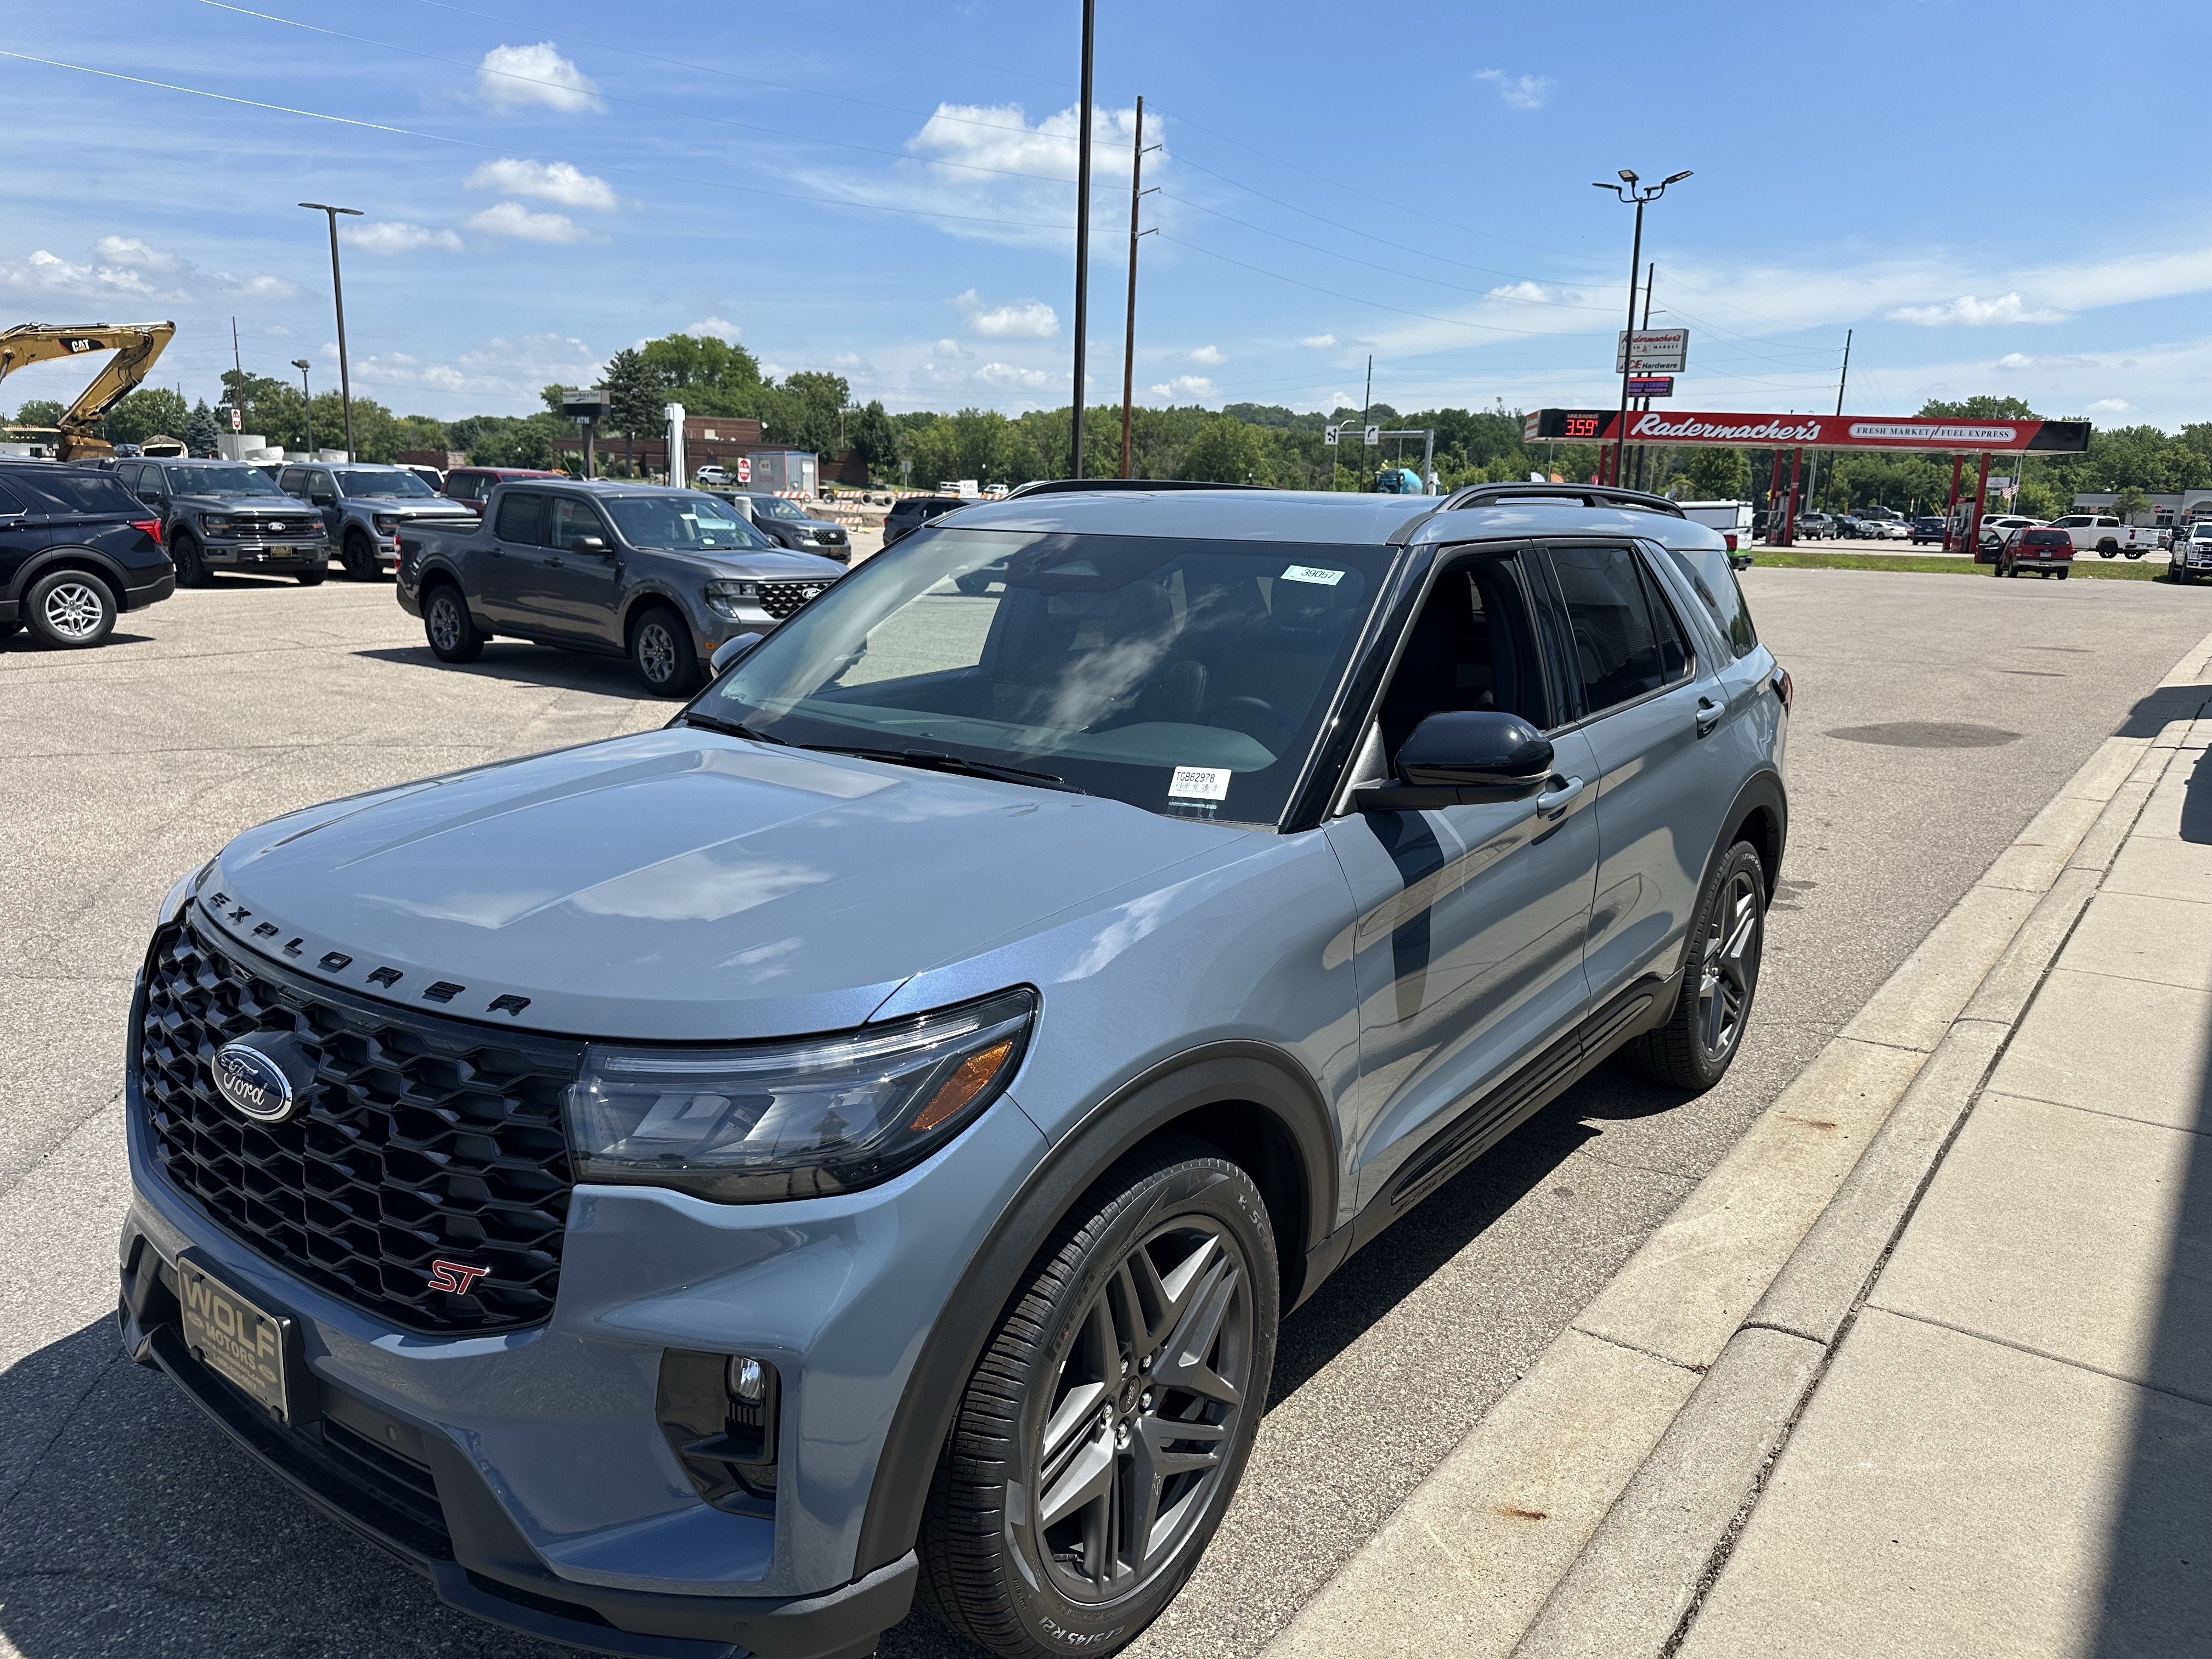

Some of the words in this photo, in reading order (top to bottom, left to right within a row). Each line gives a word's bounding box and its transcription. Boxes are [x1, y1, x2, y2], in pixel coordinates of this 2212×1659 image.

[71, 339, 89, 352] CAT
[577, 416, 590, 425] ATM
[1630, 413, 1821, 441] Radermacher's
[1968, 430, 2010, 438] EXPRESS
[1301, 569, 1336, 579] 39057
[1177, 771, 1215, 783] TGB62978
[210, 891, 531, 1016] EXPLORER
[223, 1057, 268, 1106] Ford
[428, 1260, 490, 1295] ST
[183, 1272, 274, 1358] WOLF
[205, 1321, 256, 1370] MOTORS
[1038, 1615, 1067, 1640] R21
